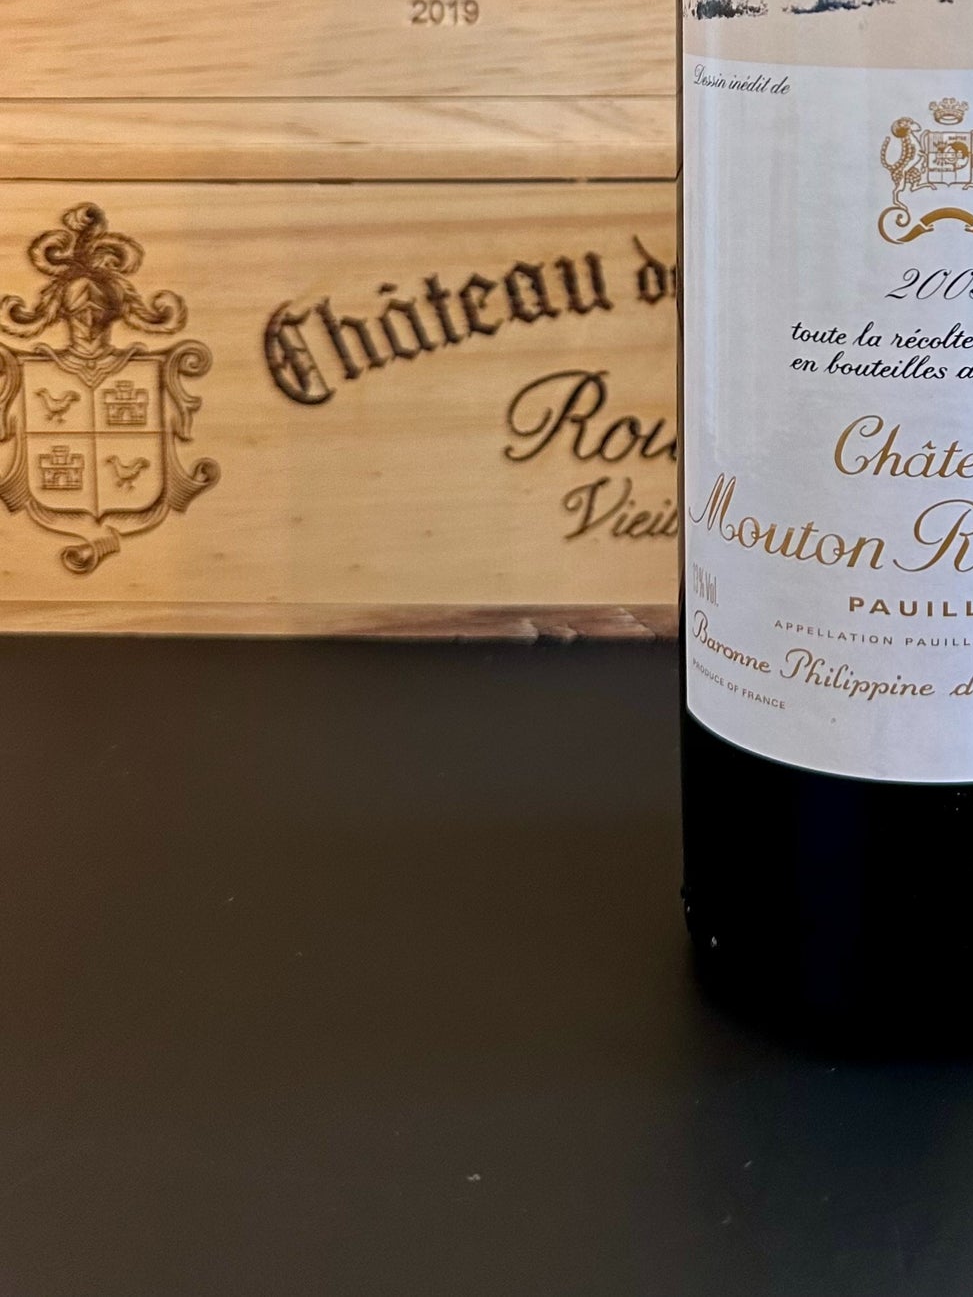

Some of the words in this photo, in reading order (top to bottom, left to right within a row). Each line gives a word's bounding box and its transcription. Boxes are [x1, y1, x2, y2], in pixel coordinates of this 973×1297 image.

[693, 63, 726, 89] Dessin
[729, 74, 771, 93] inédit
[770, 76, 791, 94] de
[264, 251, 612, 405] Château
[791, 321, 847, 345] toute
[852, 321, 881, 348] la
[790, 355, 818, 374] en
[824, 351, 948, 380] bouteilles
[689, 472, 884, 570] Mouton
[774, 619, 893, 646] APPELLATION
[692, 609, 772, 674] Baronne
[779, 647, 937, 701] Philippine
[692, 657, 725, 687] PRODUCE
[726, 681, 740, 693] OF
[742, 688, 787, 711] FRANCE
